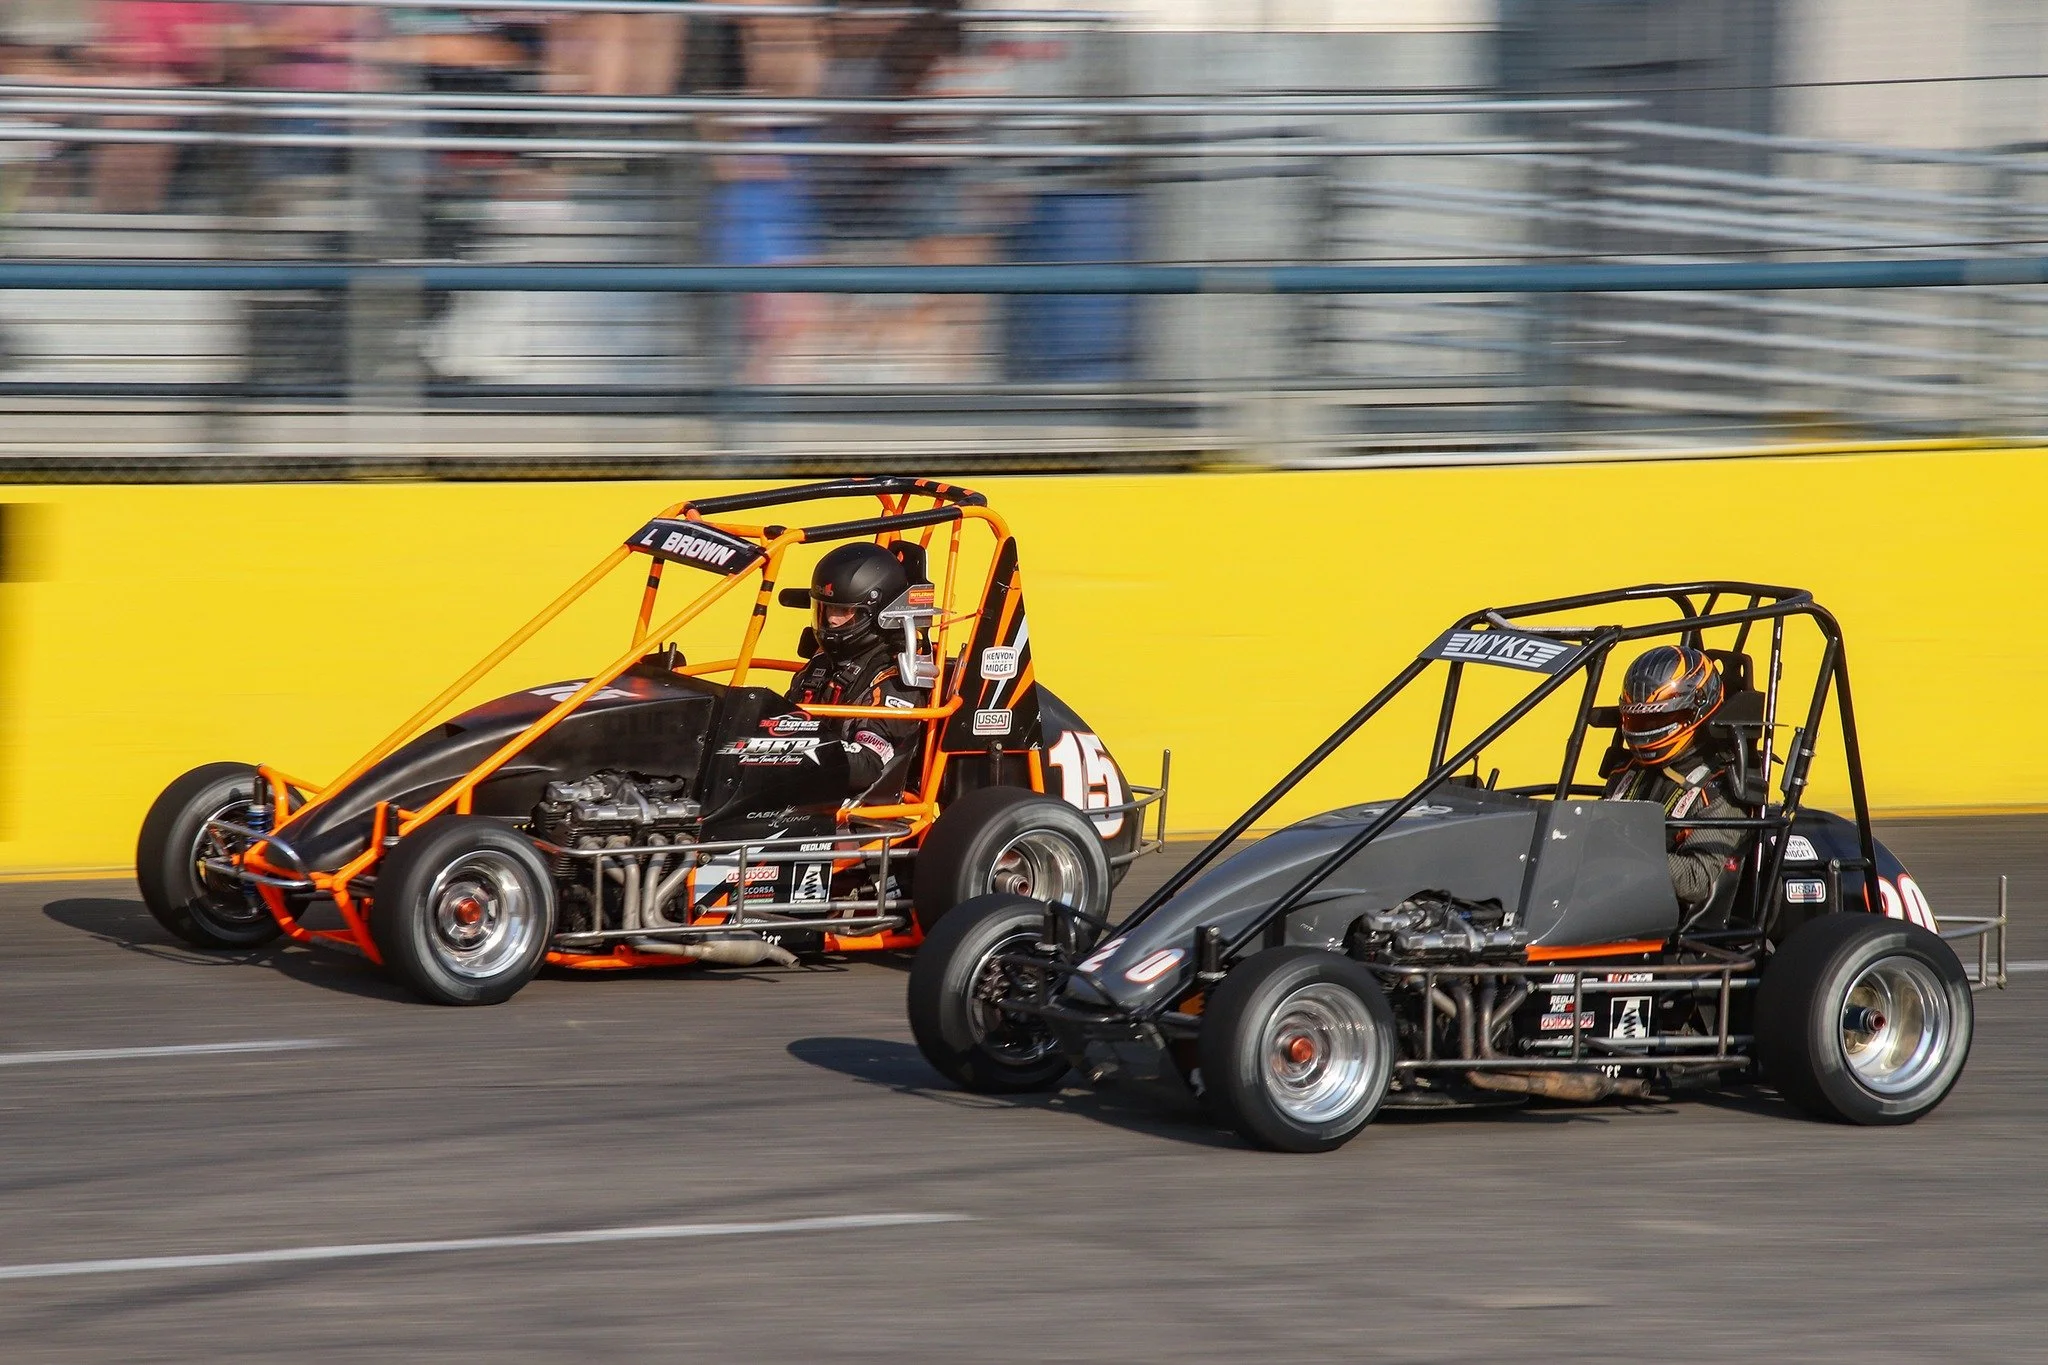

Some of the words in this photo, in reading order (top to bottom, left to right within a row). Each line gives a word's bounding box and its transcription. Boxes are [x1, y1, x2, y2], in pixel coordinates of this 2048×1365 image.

[640, 528, 658, 546] L
[661, 532, 736, 566] BROWN
[1463, 633, 1539, 661] WYKE
[986, 652, 1015, 660] KENYON
[985, 663, 1013, 672] MIDGET
[978, 714, 1004, 724] USSA
[778, 719, 821, 729] Express
[1048, 730, 1124, 839] 15
[746, 811, 779, 819] CASH
[800, 843, 832, 852] REDLINE
[1790, 885, 1818, 894] USSA
